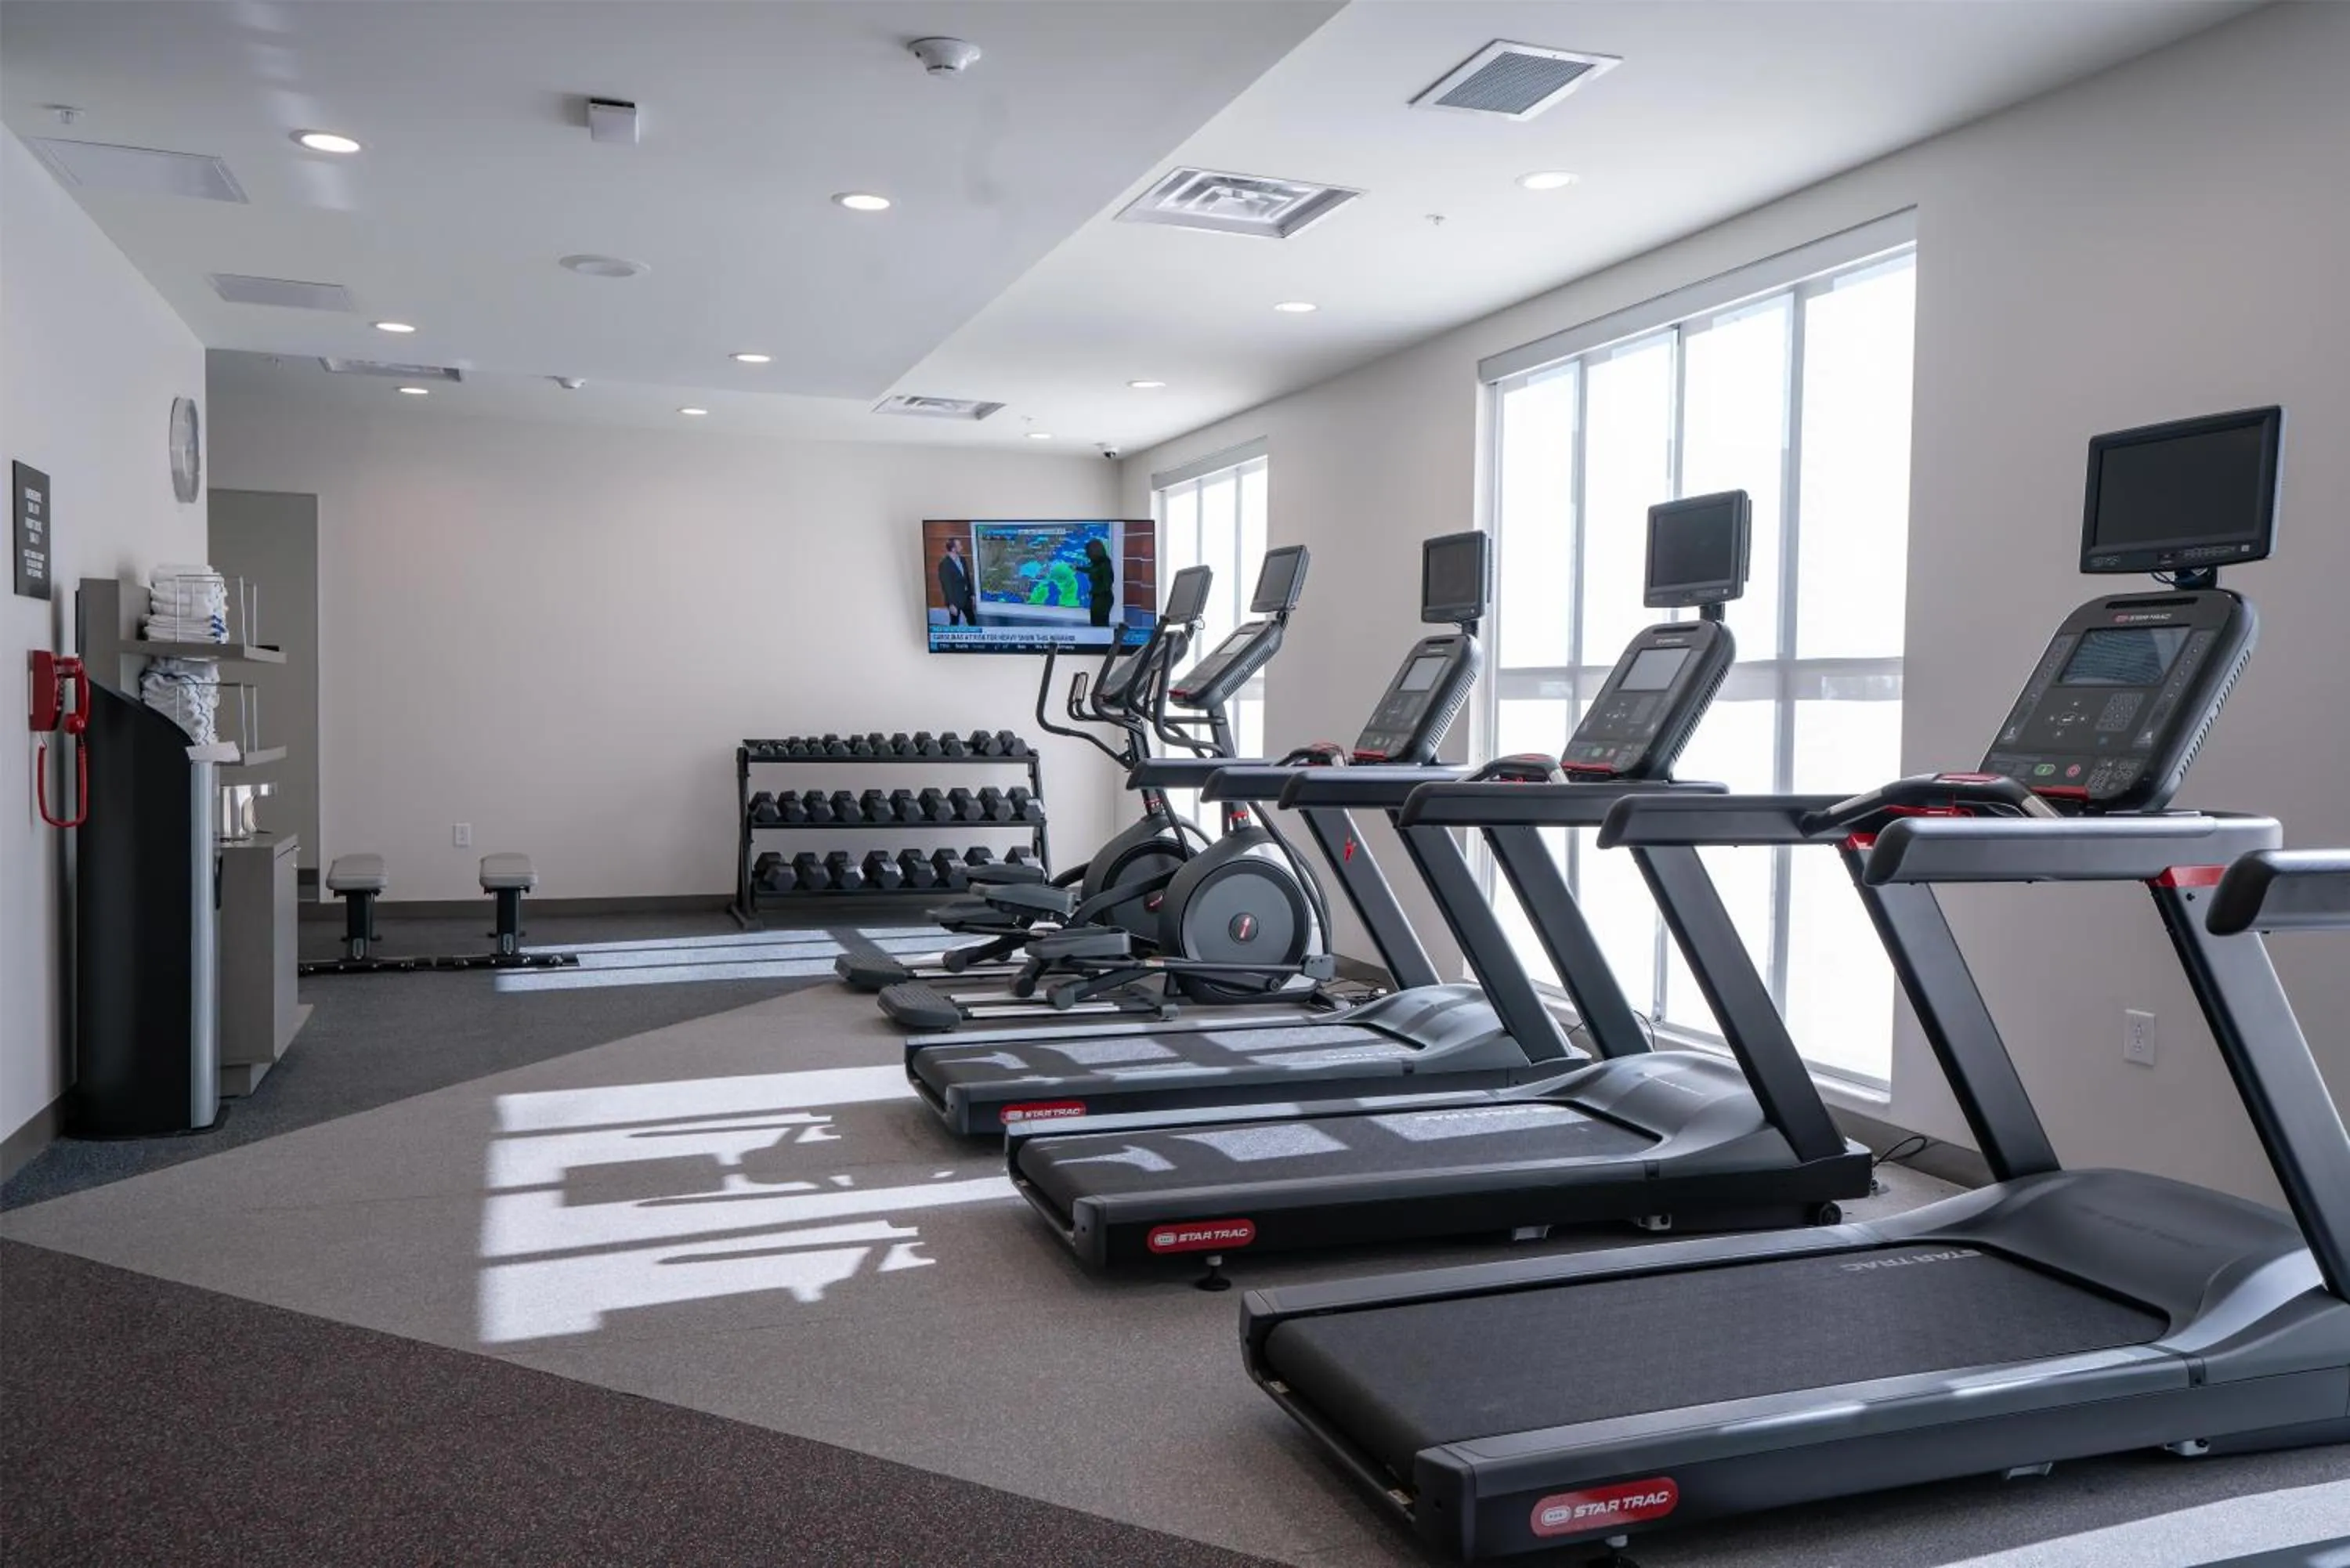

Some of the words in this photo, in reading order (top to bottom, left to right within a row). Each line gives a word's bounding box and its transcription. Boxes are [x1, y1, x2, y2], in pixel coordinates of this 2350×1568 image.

[1025, 1109, 1051, 1118] STAR
[1177, 1231, 1212, 1243] STAR
[1214, 1227, 1249, 1240] TRAC
[1840, 1256, 1914, 1271] TRAC
[1574, 1500, 1620, 1518] STAR
[1622, 1491, 1670, 1509] TRAC
